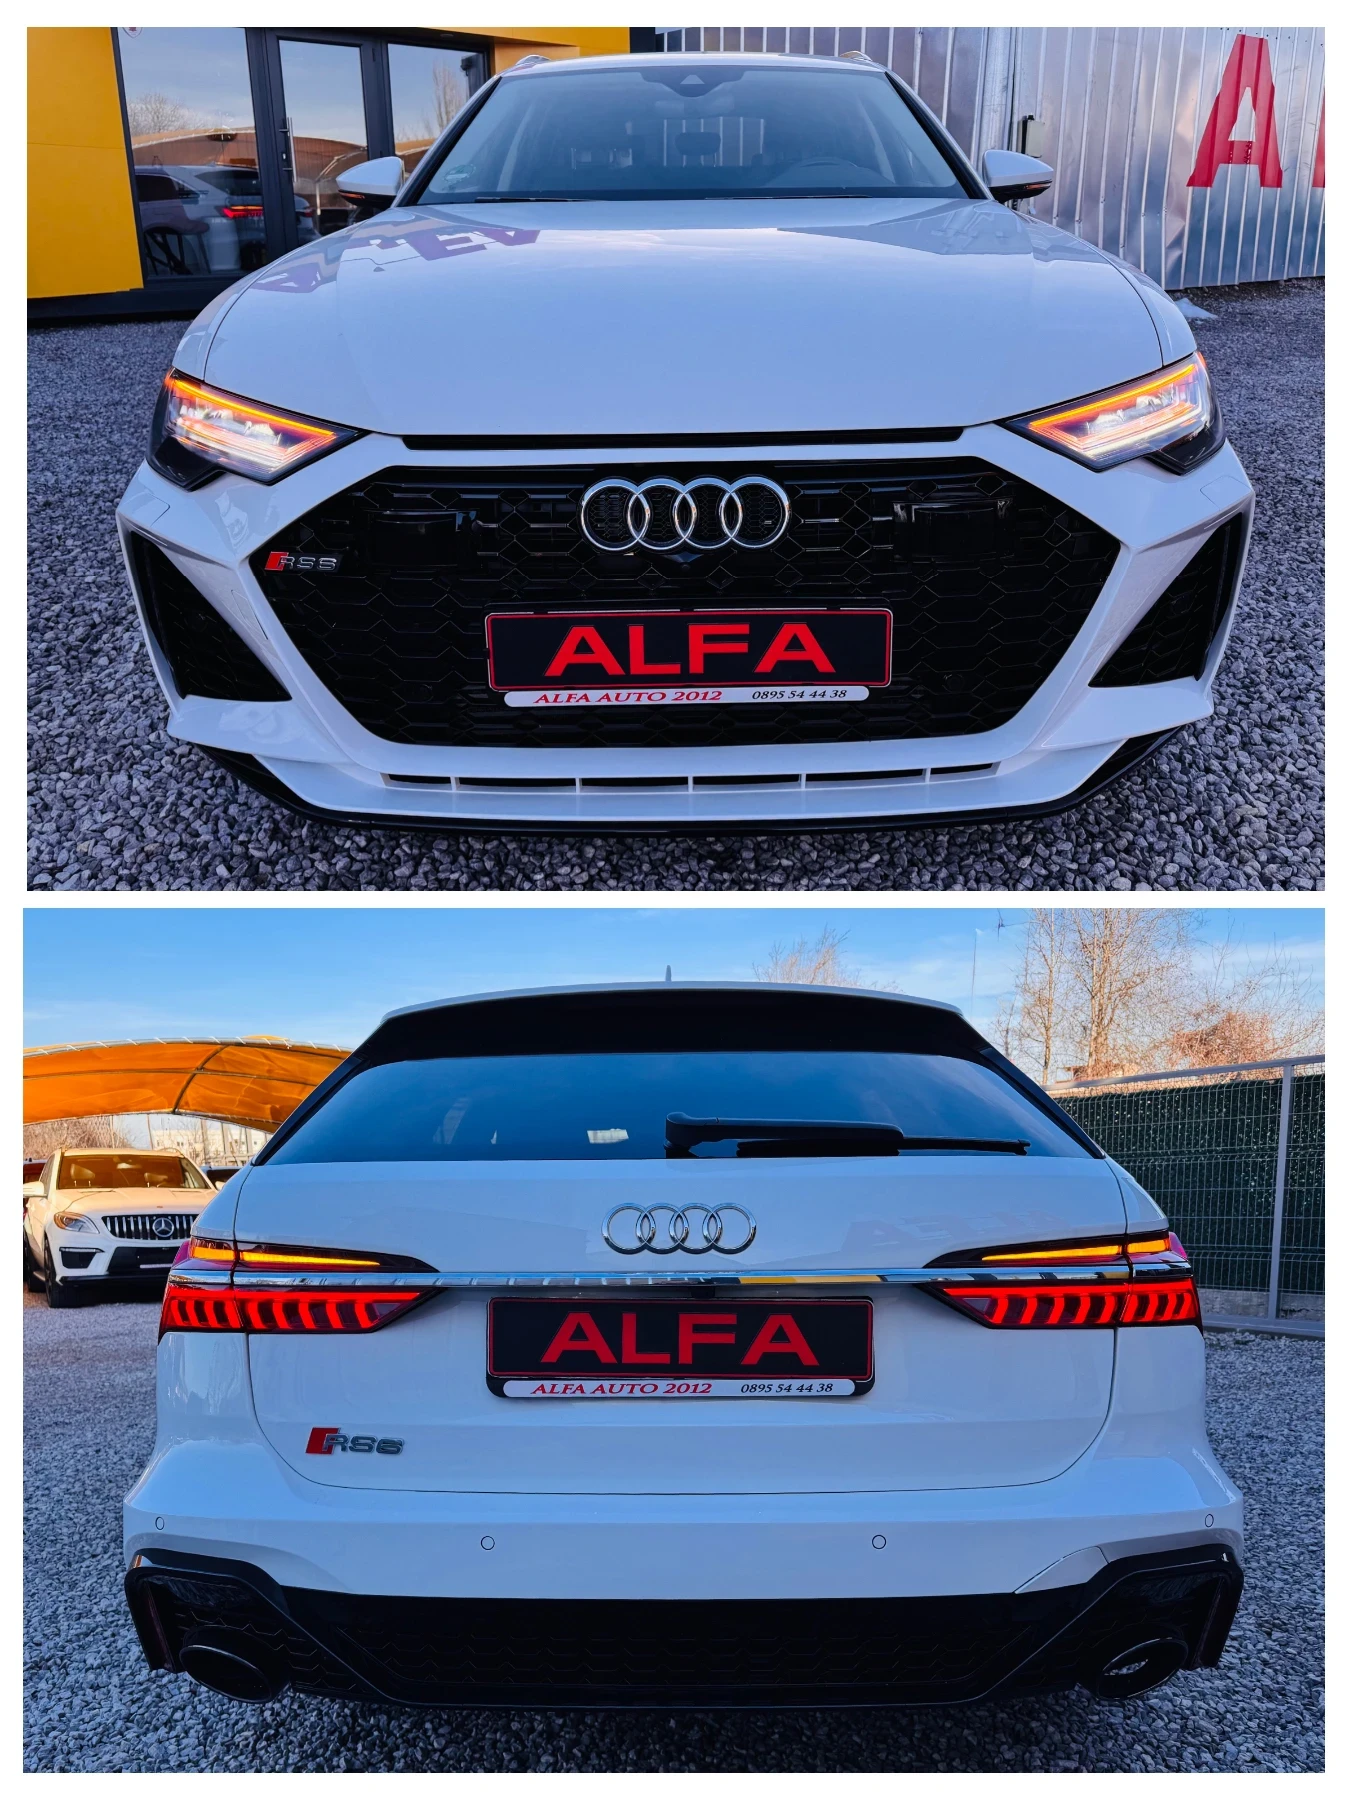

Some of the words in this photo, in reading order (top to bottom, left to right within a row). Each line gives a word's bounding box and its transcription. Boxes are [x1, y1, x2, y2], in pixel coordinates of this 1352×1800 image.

[1186, 33, 1325, 188] A
[543, 622, 837, 677] ALFA
[533, 692, 592, 704] ALFA
[596, 691, 667, 703] AUTO
[671, 690, 723, 702] 2012
[751, 690, 786, 700] 0895
[787, 690, 806, 700] 54
[808, 689, 827, 699] 44
[829, 689, 848, 699] 38
[540, 1311, 820, 1367] ALFA
[530, 1383, 587, 1395] ALFA
[590, 1382, 660, 1395] AUTO
[663, 1382, 713, 1394] 2012
[740, 1383, 774, 1394] 0895
[775, 1383, 793, 1393] 54
[795, 1383, 814, 1393] 44
[816, 1383, 834, 1393] 38
[320, 1430, 405, 1455] RS6
